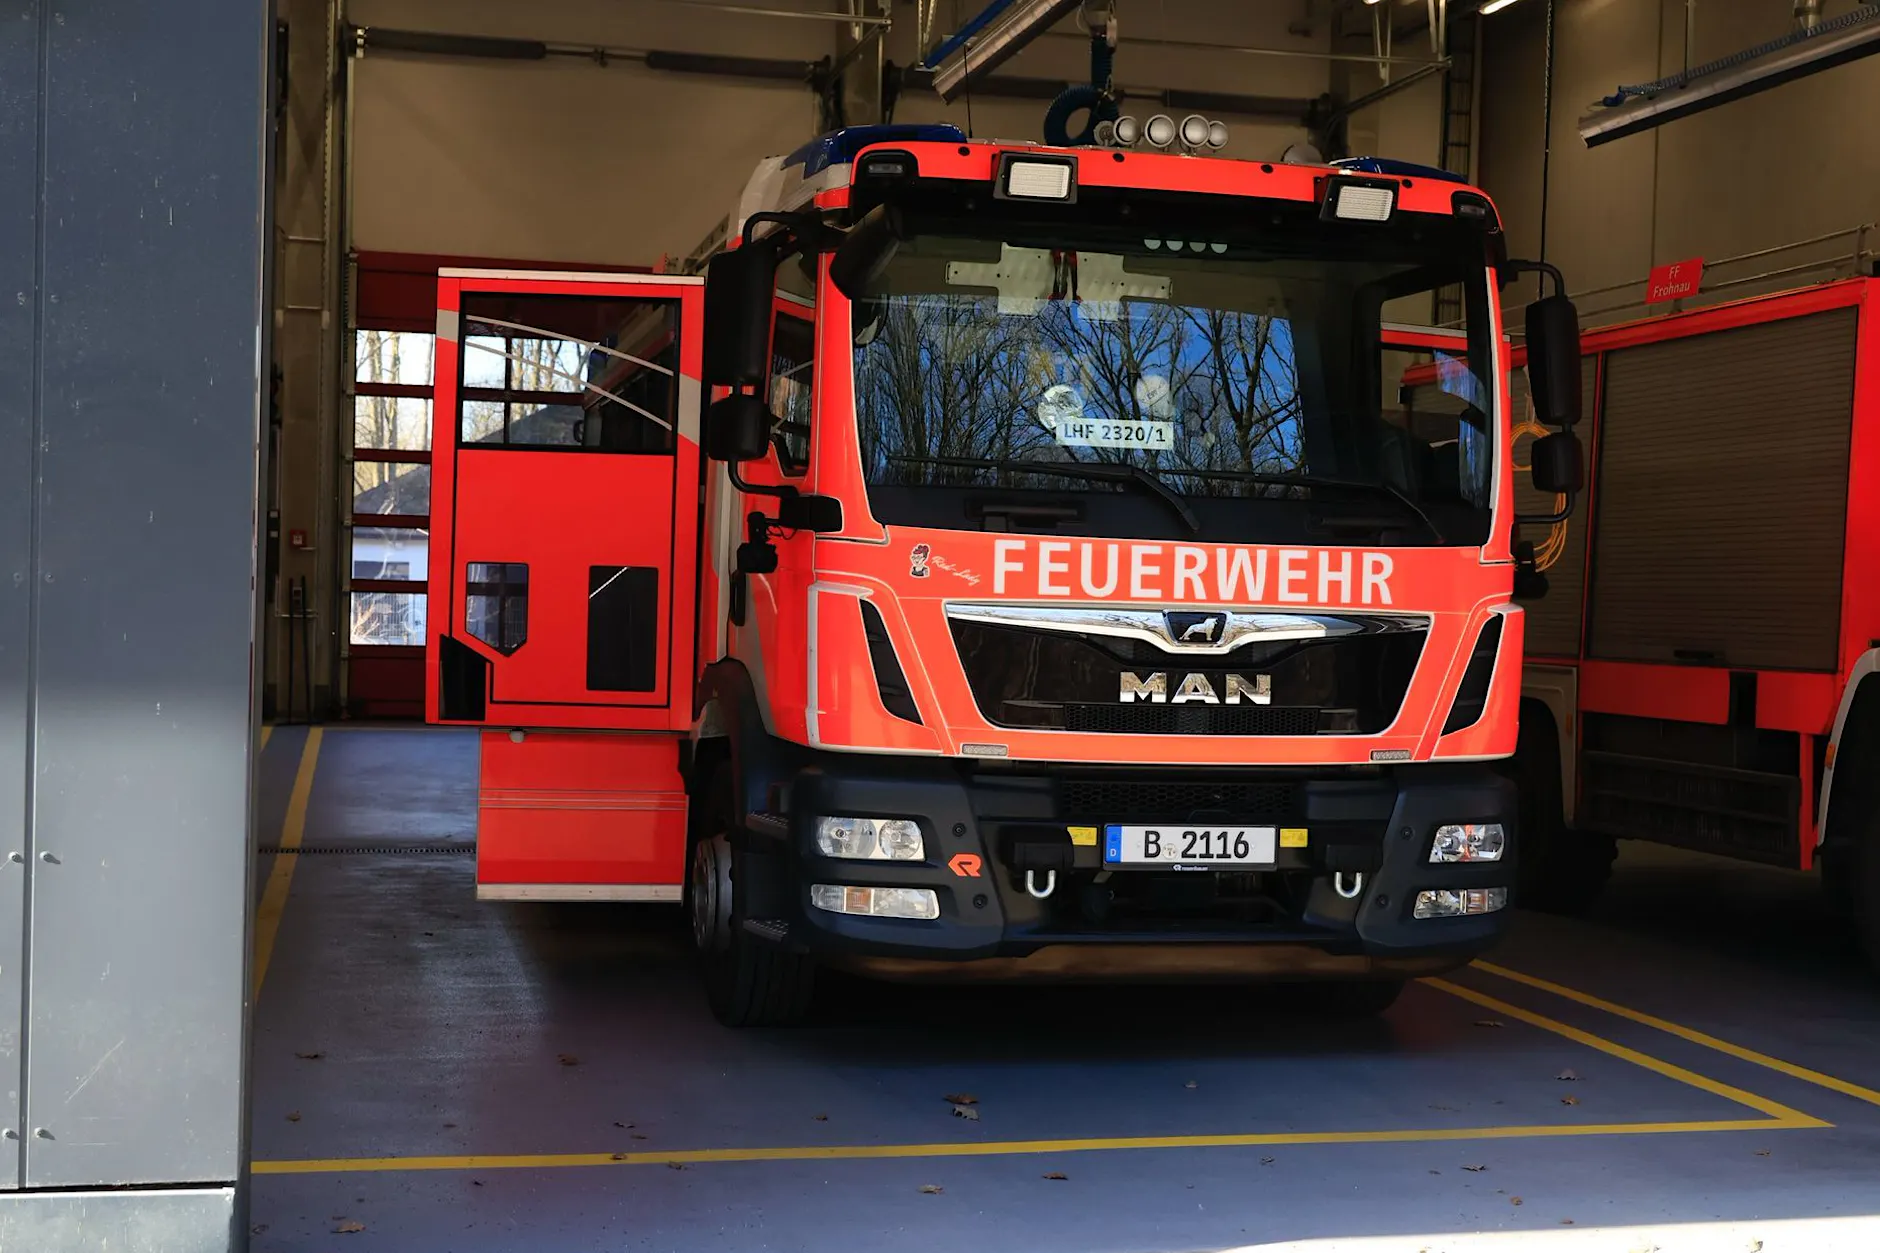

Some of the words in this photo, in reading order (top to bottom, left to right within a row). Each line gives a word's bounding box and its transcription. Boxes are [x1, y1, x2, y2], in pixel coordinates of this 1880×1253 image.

[1669, 265, 1680, 279] FF
[1653, 282, 1691, 298] Frohnau
[1064, 423, 1094, 439] LHF
[1101, 425, 1166, 444] 2320/1
[993, 539, 1394, 605] FEUERWEHR
[1119, 671, 1272, 705] MAN
[1144, 830, 1161, 858] B
[1181, 831, 1250, 859] 2116
